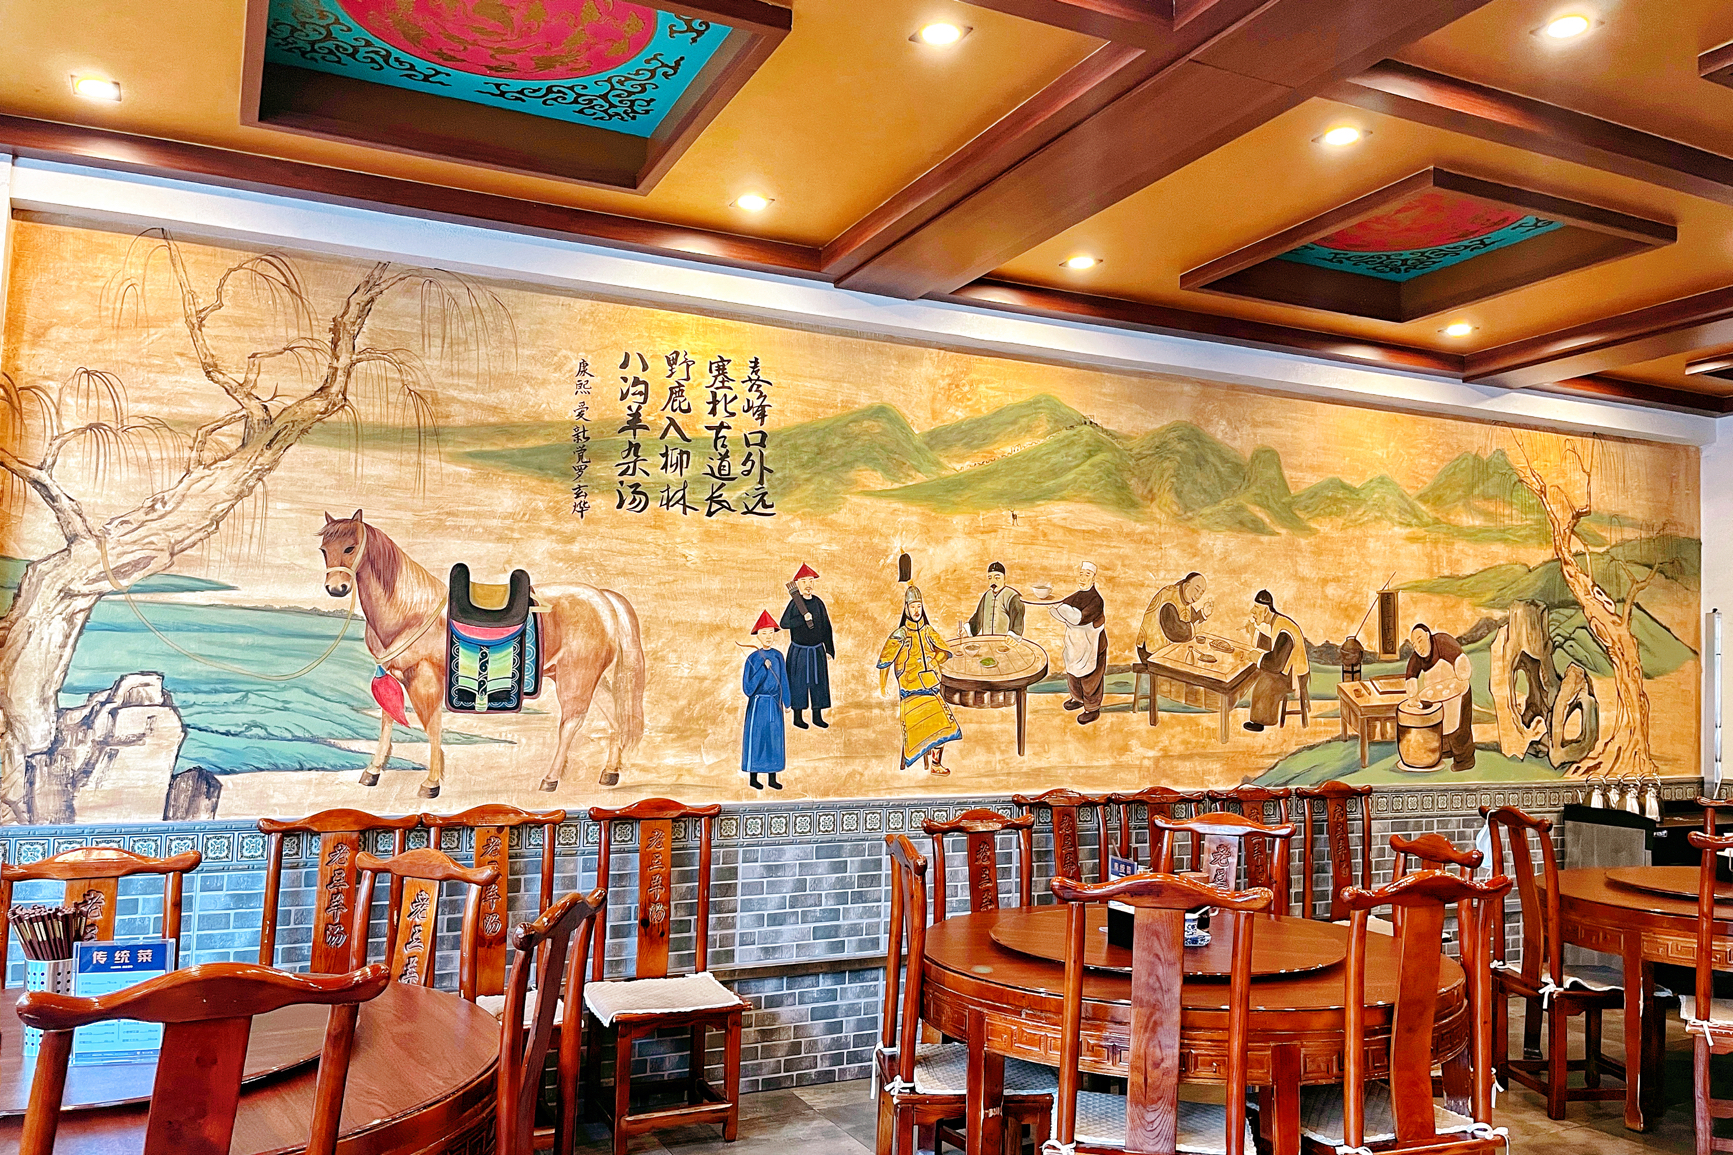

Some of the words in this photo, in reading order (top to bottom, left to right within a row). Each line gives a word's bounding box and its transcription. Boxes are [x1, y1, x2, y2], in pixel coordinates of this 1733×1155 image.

[615, 351, 650, 513] 八沟羊杂汤
[659, 350, 700, 516] 野鹿入柳林
[703, 355, 738, 518] 塞北古道长
[741, 357, 776, 517] 喜峰口外远
[92, 949, 153, 965] 传统菜
[325, 843, 351, 949] 老三羊汤
